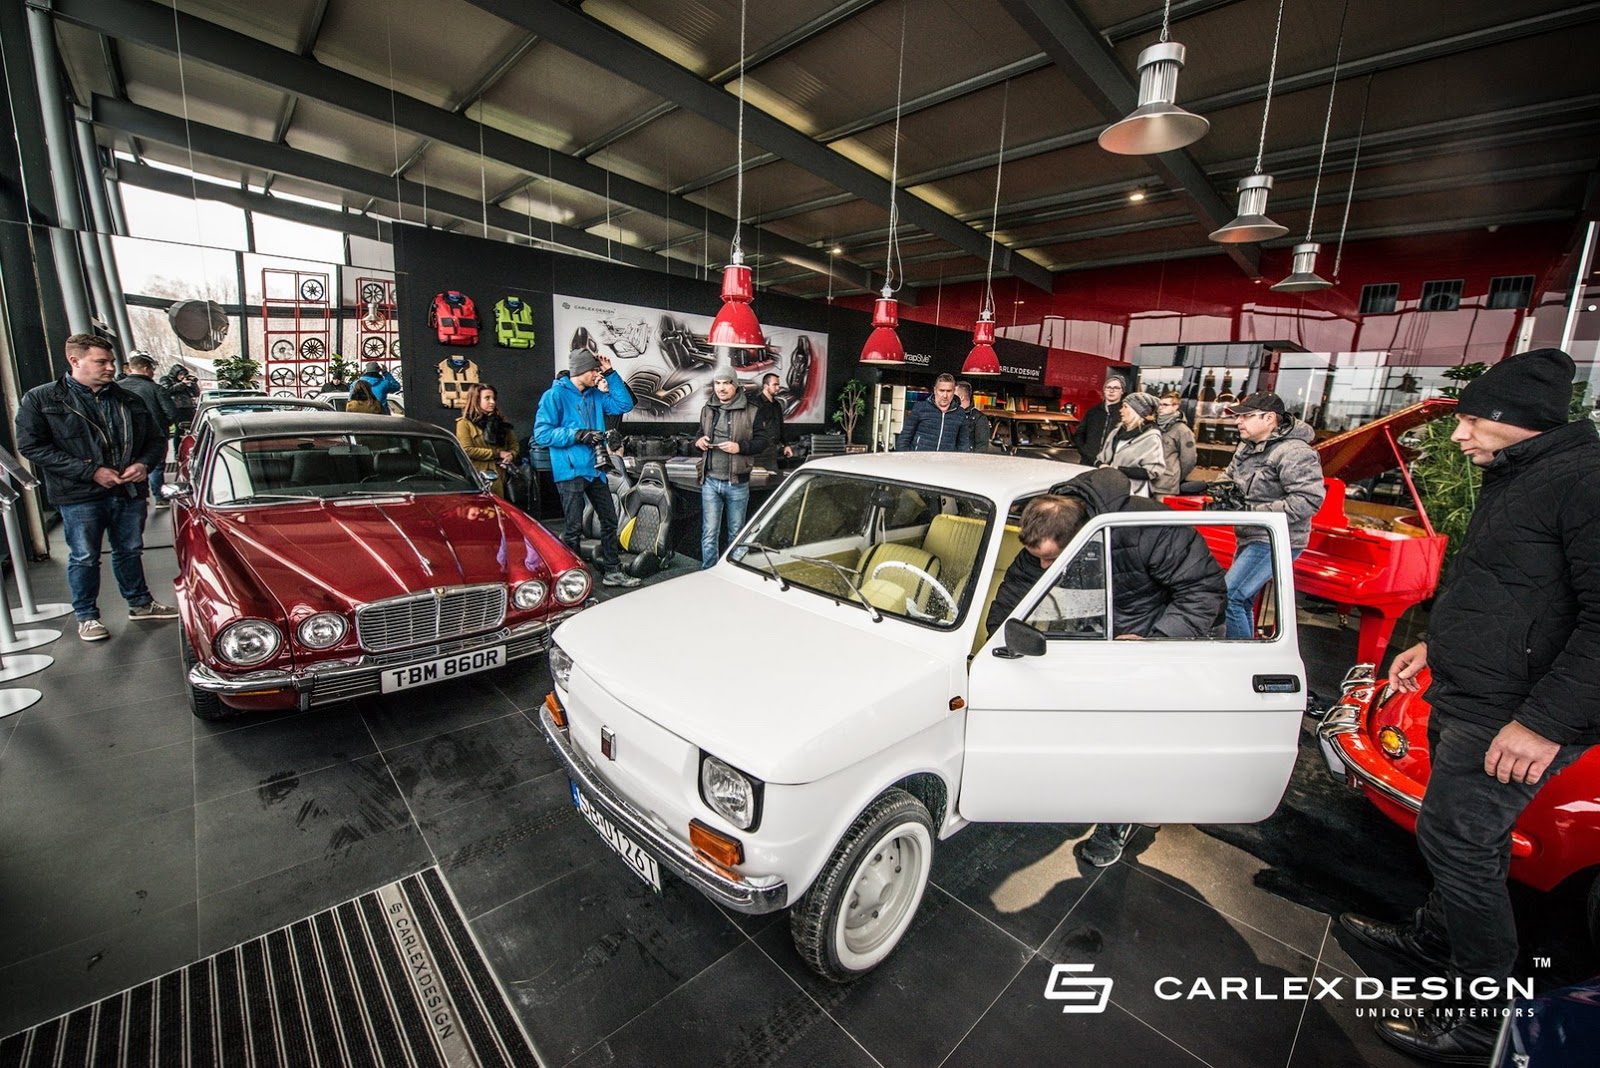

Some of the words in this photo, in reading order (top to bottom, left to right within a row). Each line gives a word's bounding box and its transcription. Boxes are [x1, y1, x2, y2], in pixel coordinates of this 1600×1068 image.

[903, 351, 930, 363] rapStyle
[999, 365, 1019, 374] ARLEX
[1018, 367, 1040, 377] DESIGN
[392, 662, 438, 687] TBM
[444, 649, 499, 676] 860R
[396, 917, 427, 975] CARLEX
[418, 973, 455, 1040] DESIGN
